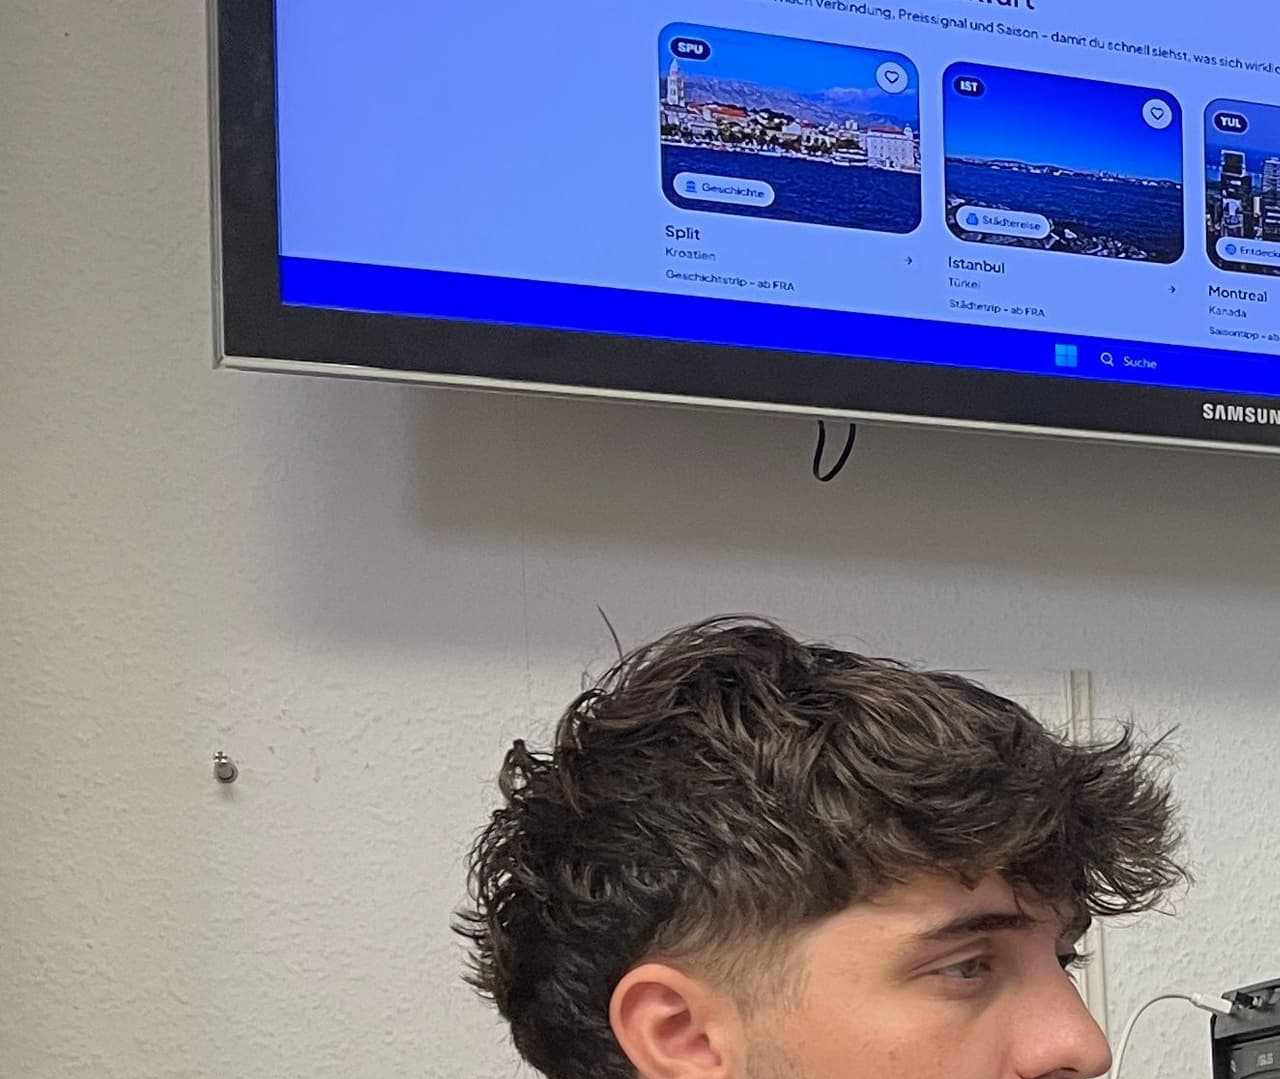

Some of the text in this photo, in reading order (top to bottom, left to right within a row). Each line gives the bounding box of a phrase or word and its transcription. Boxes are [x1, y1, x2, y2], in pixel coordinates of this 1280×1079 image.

[899, 9, 968, 29] Preissignal
[969, 20, 995, 33] und
[997, 23, 1039, 40] Saison
[1051, 32, 1087, 47] damit
[1088, 37, 1105, 48] du
[1107, 41, 1150, 55] schnell
[1193, 54, 1217, 66] was
[1219, 56, 1243, 69] sich
[676, 42, 704, 55] SPU
[960, 80, 978, 92] IST
[1220, 116, 1242, 128] YUL
[701, 182, 765, 198] Geschichte
[982, 214, 1041, 231] Städtereise
[665, 225, 701, 241] Split
[665, 248, 717, 261] Kroatien
[948, 256, 1005, 274] Istanbul
[666, 269, 795, 292] Geschichtstrip ab FRA
[948, 277, 981, 289] Türkei
[1208, 285, 1268, 302] Montreal
[949, 299, 1046, 317] Städtetrip ab FRA
[1208, 305, 1247, 318] Kanada
[1123, 356, 1157, 369] Suche
